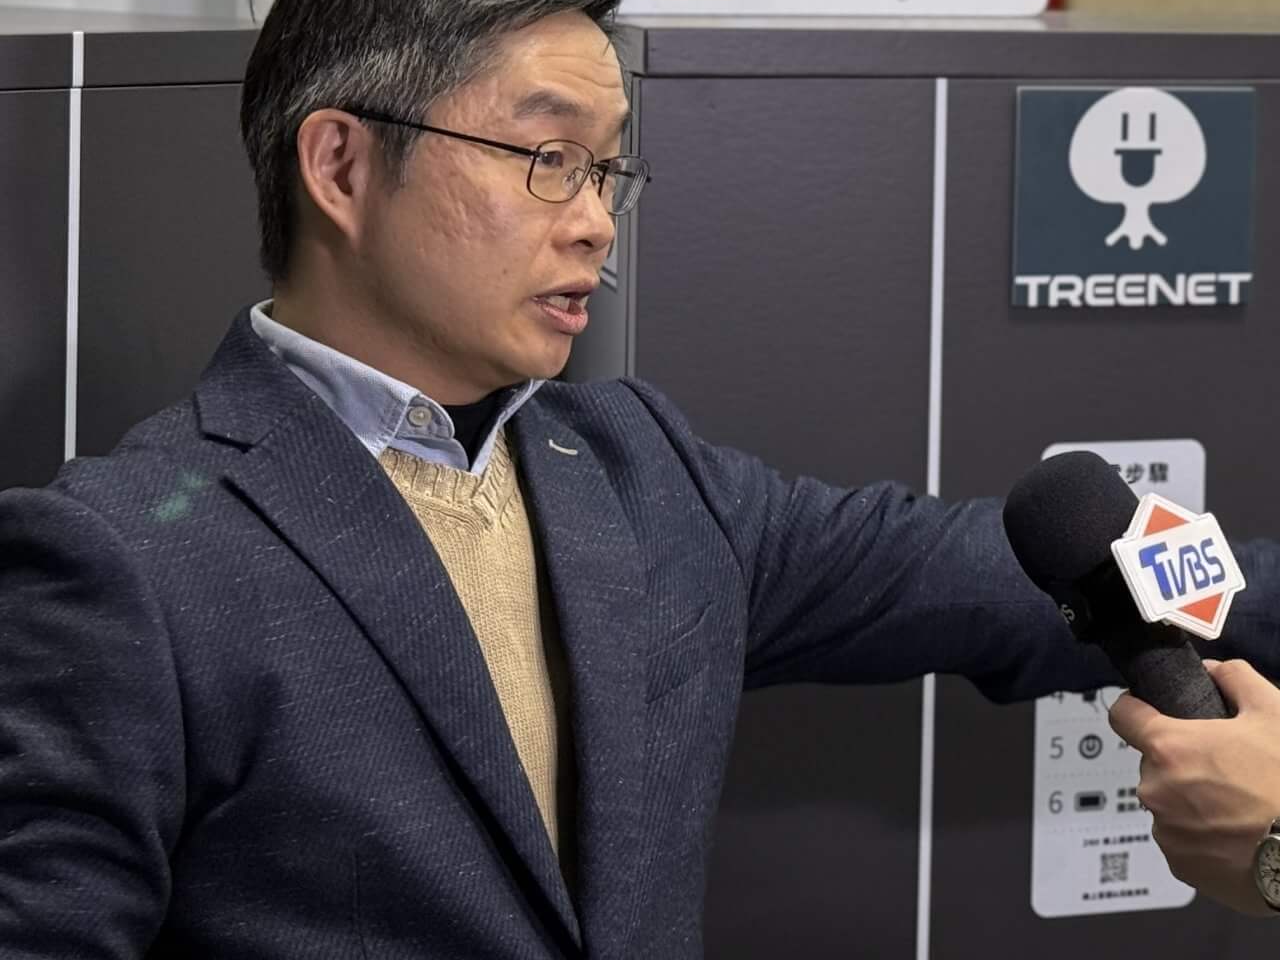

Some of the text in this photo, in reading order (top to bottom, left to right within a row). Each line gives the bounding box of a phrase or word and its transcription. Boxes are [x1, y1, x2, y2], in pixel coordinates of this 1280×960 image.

[1015, 273, 1253, 307] TREENET
[1111, 462, 1170, 484] 步驟
[1138, 537, 1226, 601] TVBS
[1050, 736, 1064, 760] 5
[1049, 791, 1064, 815] 6
